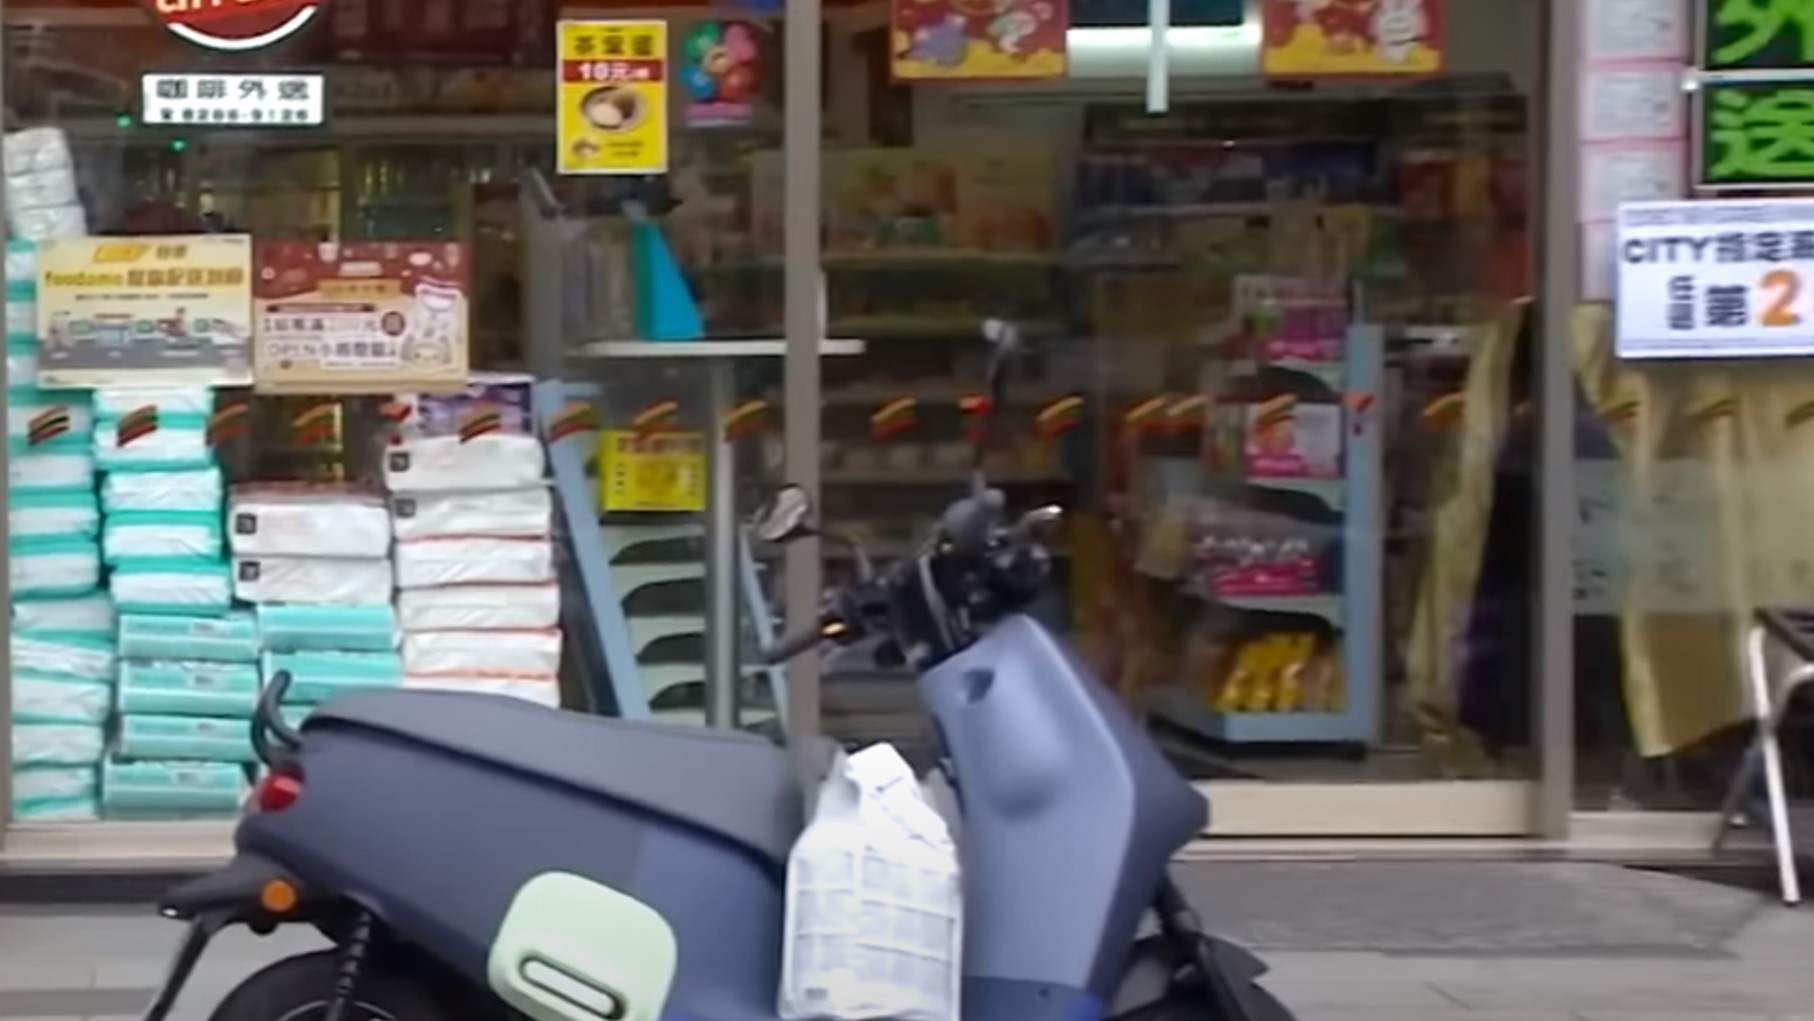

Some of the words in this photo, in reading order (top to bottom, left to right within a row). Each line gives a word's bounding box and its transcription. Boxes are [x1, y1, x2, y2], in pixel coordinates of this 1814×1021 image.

[574, 35, 653, 55] 茶葉蛋
[157, 79, 309, 99] 咖啡外送
